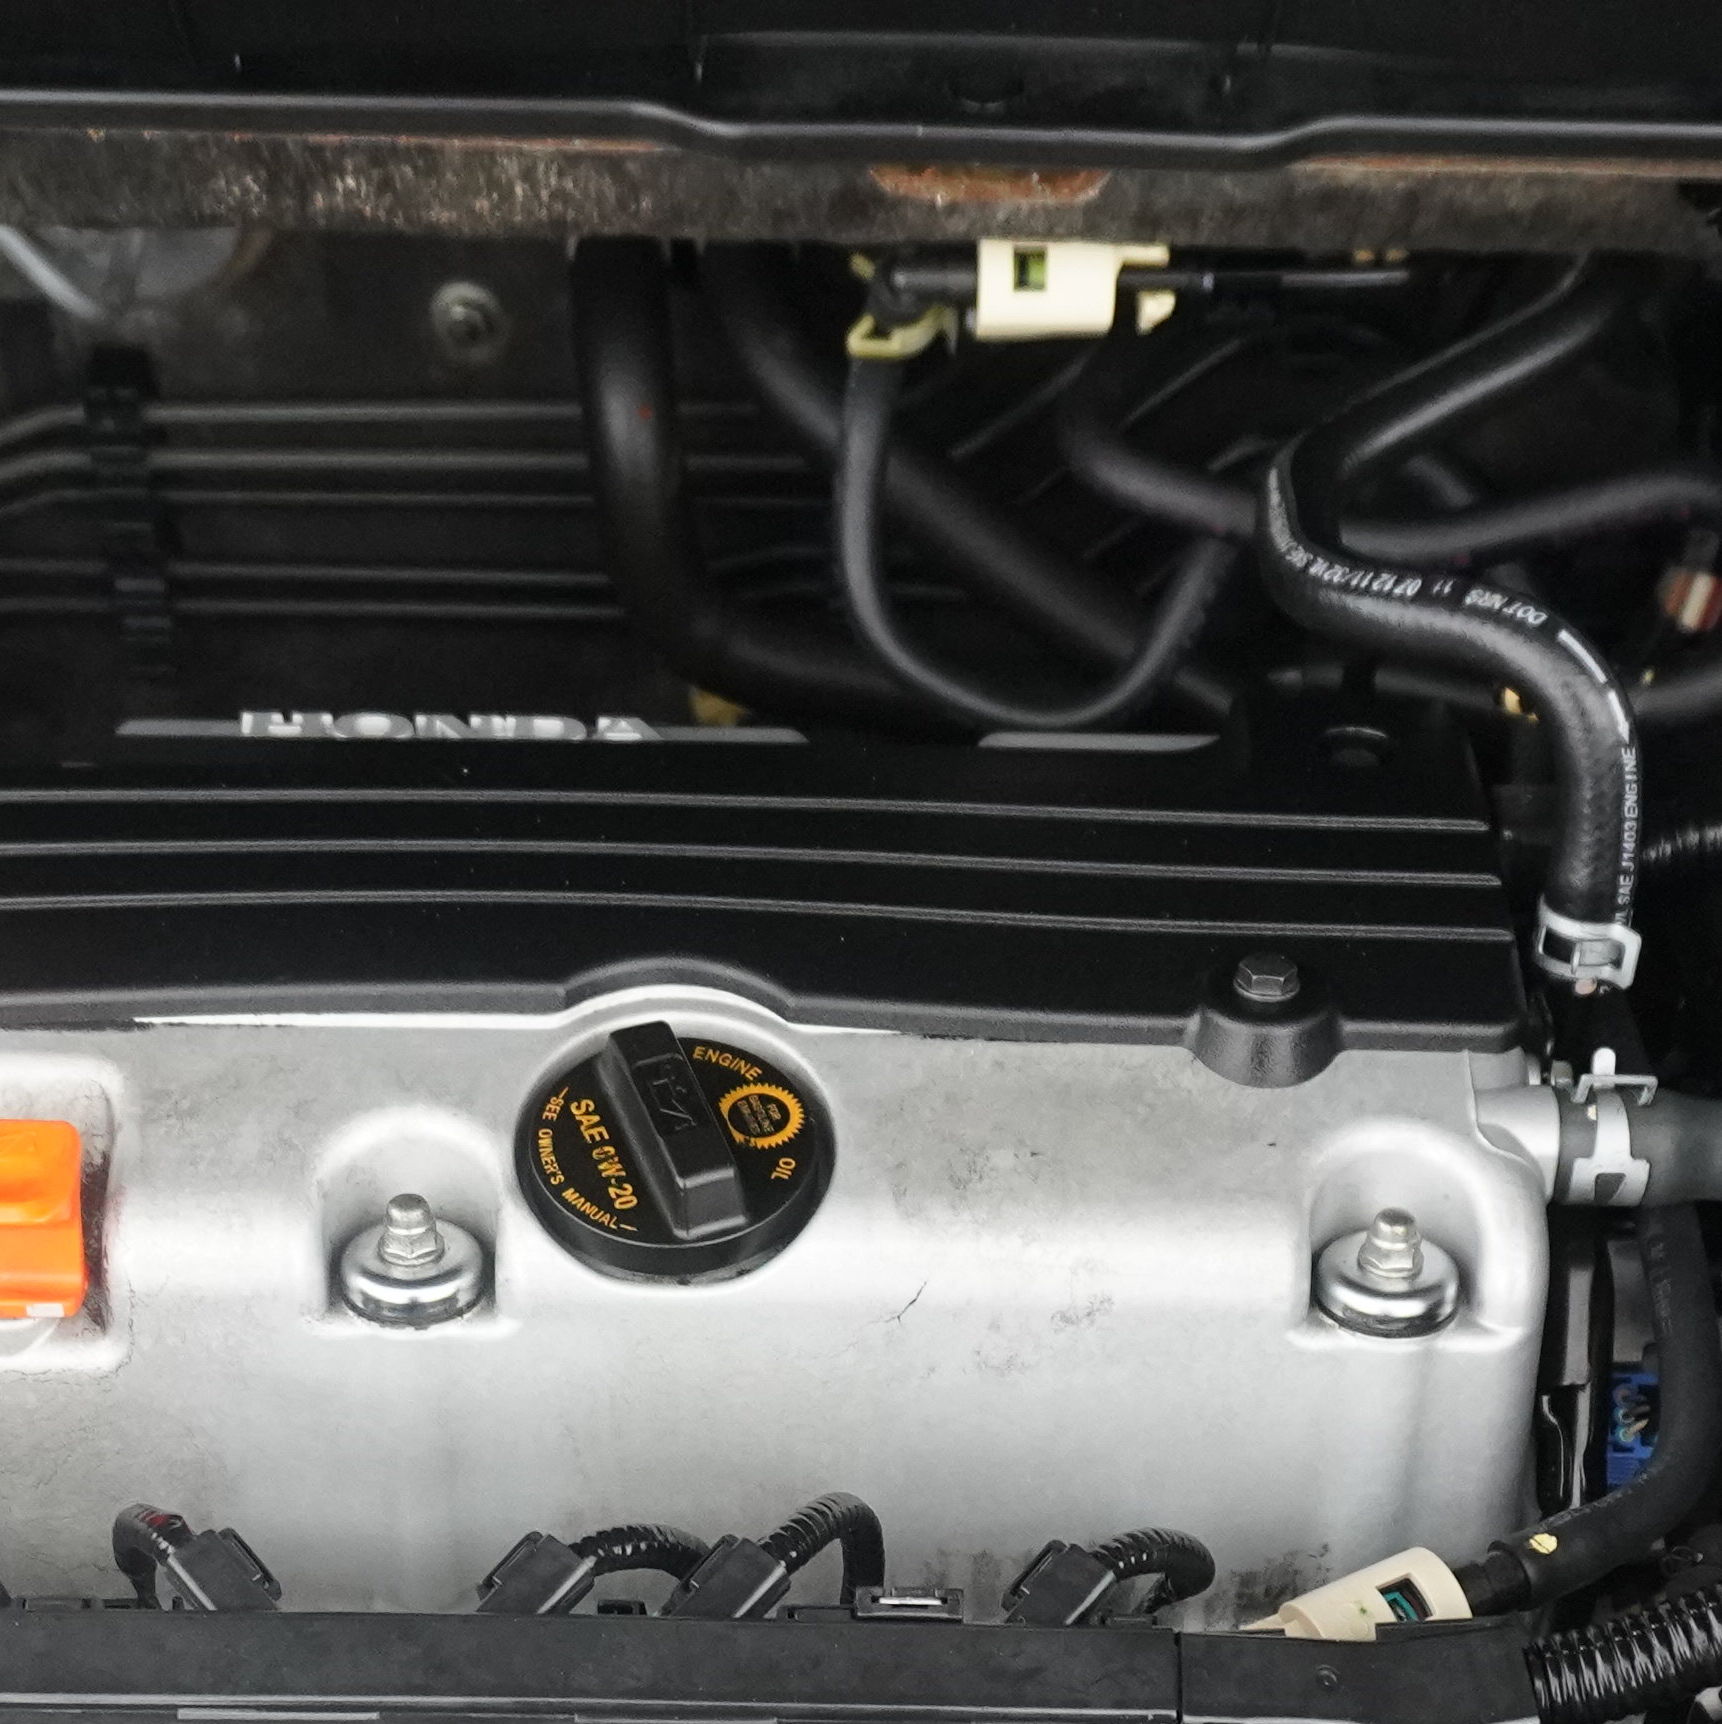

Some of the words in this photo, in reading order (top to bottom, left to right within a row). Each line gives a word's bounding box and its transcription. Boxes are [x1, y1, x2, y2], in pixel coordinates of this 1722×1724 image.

[241, 711, 664, 741] HONDA
[1621, 747, 1638, 819] ENGINE
[1621, 821, 1637, 871] J1403
[1618, 875, 1635, 905] SAE
[692, 1046, 764, 1081] ENGINE
[543, 1095, 565, 1122] SEE
[538, 1127, 565, 1186] OWNER'S
[570, 1098, 610, 1144] SAE
[592, 1145, 638, 1211] 0W-20
[771, 1156, 796, 1181] OIL
[561, 1188, 618, 1230] MANUAL
